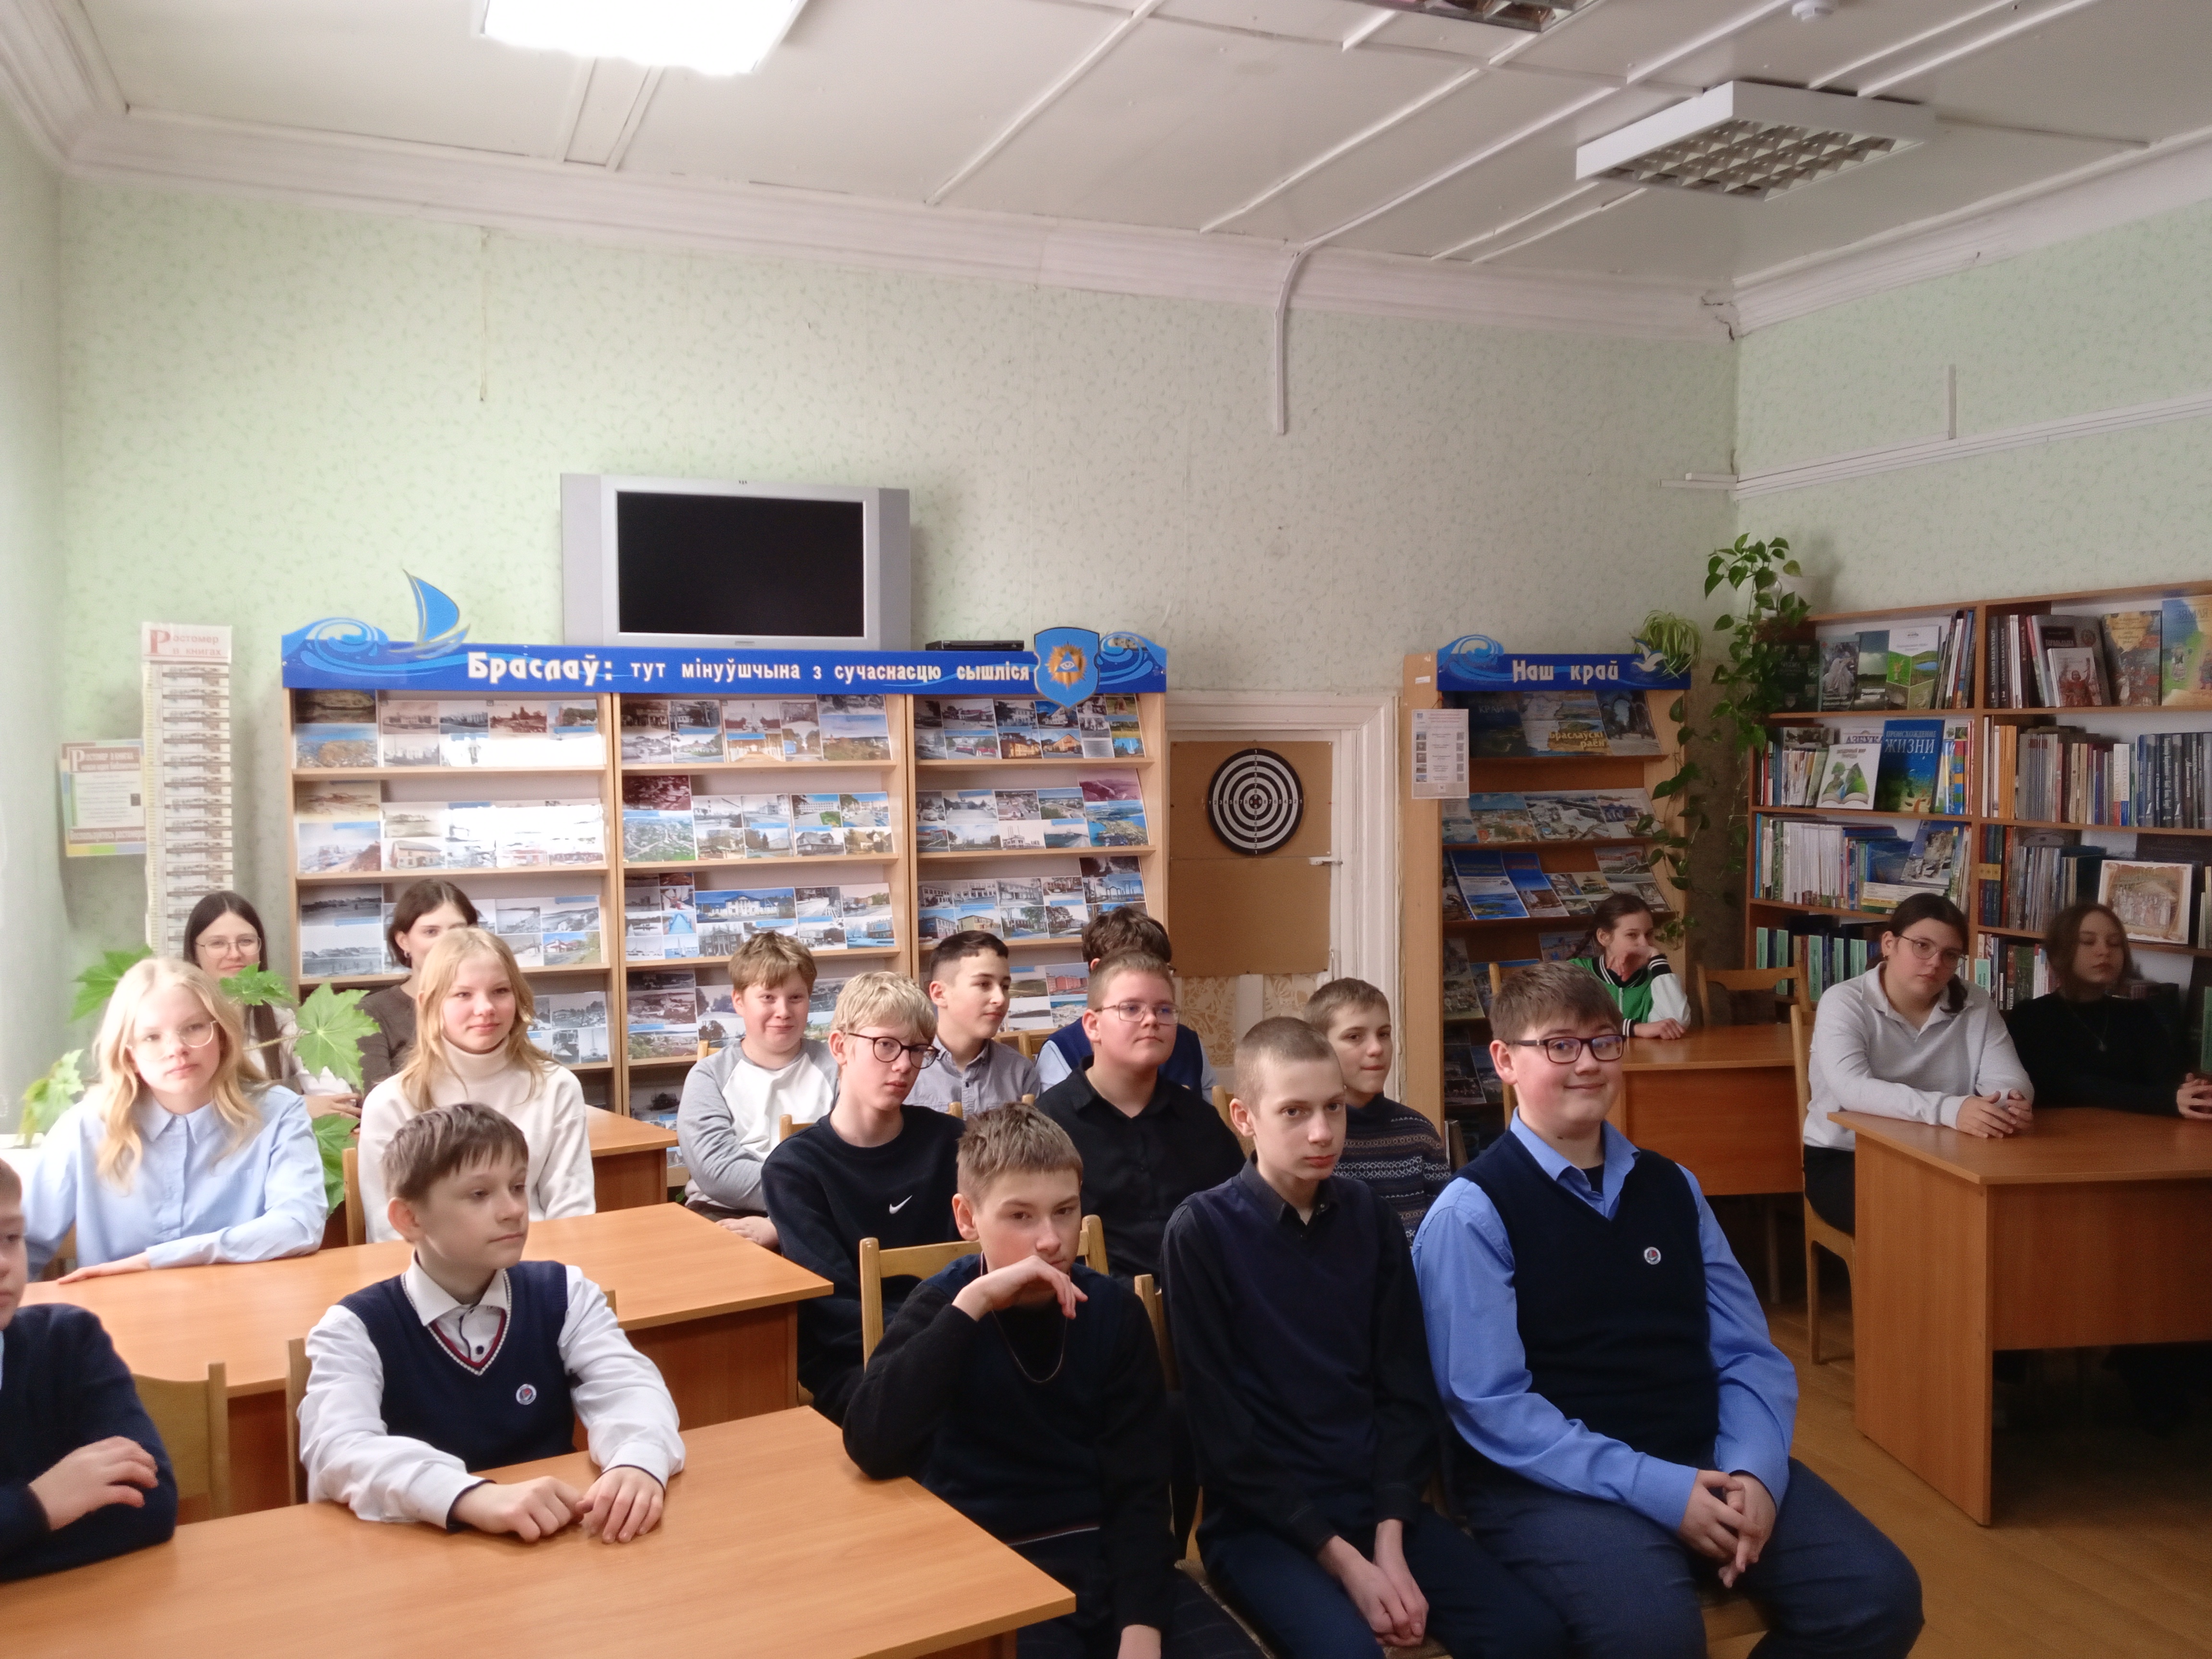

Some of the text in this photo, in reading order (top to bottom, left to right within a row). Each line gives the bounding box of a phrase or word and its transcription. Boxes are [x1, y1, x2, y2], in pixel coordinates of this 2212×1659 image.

[150, 629, 219, 654] Ростомер
[468, 651, 1030, 686] Браслаў: тут мінуўшчына з сучаснасцю сышліся
[1513, 660, 1619, 685] Наш край
[1885, 738, 1936, 753] ЖИЗНИ
